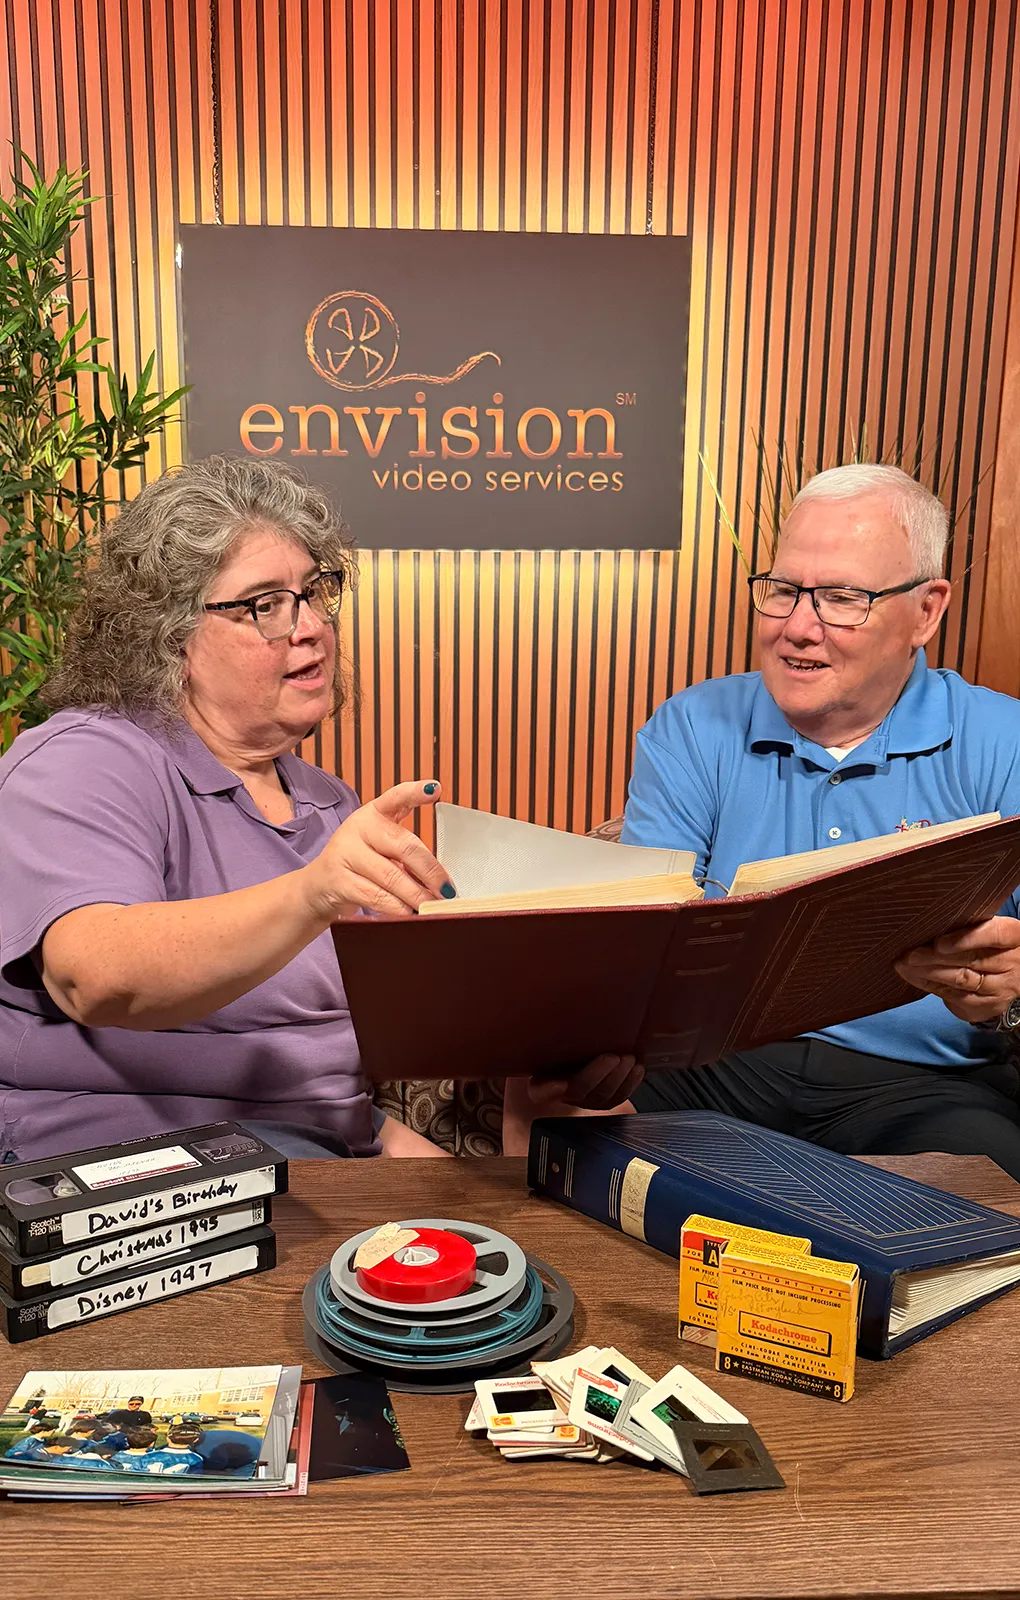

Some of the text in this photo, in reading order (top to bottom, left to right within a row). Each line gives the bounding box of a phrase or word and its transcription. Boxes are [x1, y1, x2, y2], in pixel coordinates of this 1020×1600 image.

[615, 392, 637, 406] SM
[238, 391, 624, 460] envision
[372, 463, 624, 492] video services
[88, 1178, 238, 1234] David's Birthday
[28, 1227, 47, 1237] T-120
[180, 1216, 219, 1243] 1995
[708, 1249, 719, 1266] A
[77, 1262, 212, 1317] Disney 1997
[732, 1268, 799, 1287] DAYLIGHT
[811, 1286, 842, 1298] TYPE
[745, 1282, 759, 1290] PRICE
[761, 1285, 774, 1293] DOES
[788, 1292, 808, 1301] INCLUDE
[810, 1296, 841, 1309] PROCESSING
[751, 1319, 817, 1344] Kodachrome
[724, 1356, 731, 1370] 8
[740, 1342, 827, 1368] CINE-KODAK MOVIE FILM
[762, 1354, 779, 1363] ROLL
[782, 1359, 814, 1372] CAMERAS
[817, 1368, 836, 1378] ONLY
[741, 1364, 824, 1390] EASTMAN KODAK COMPANY
[833, 1384, 841, 1398] 8
